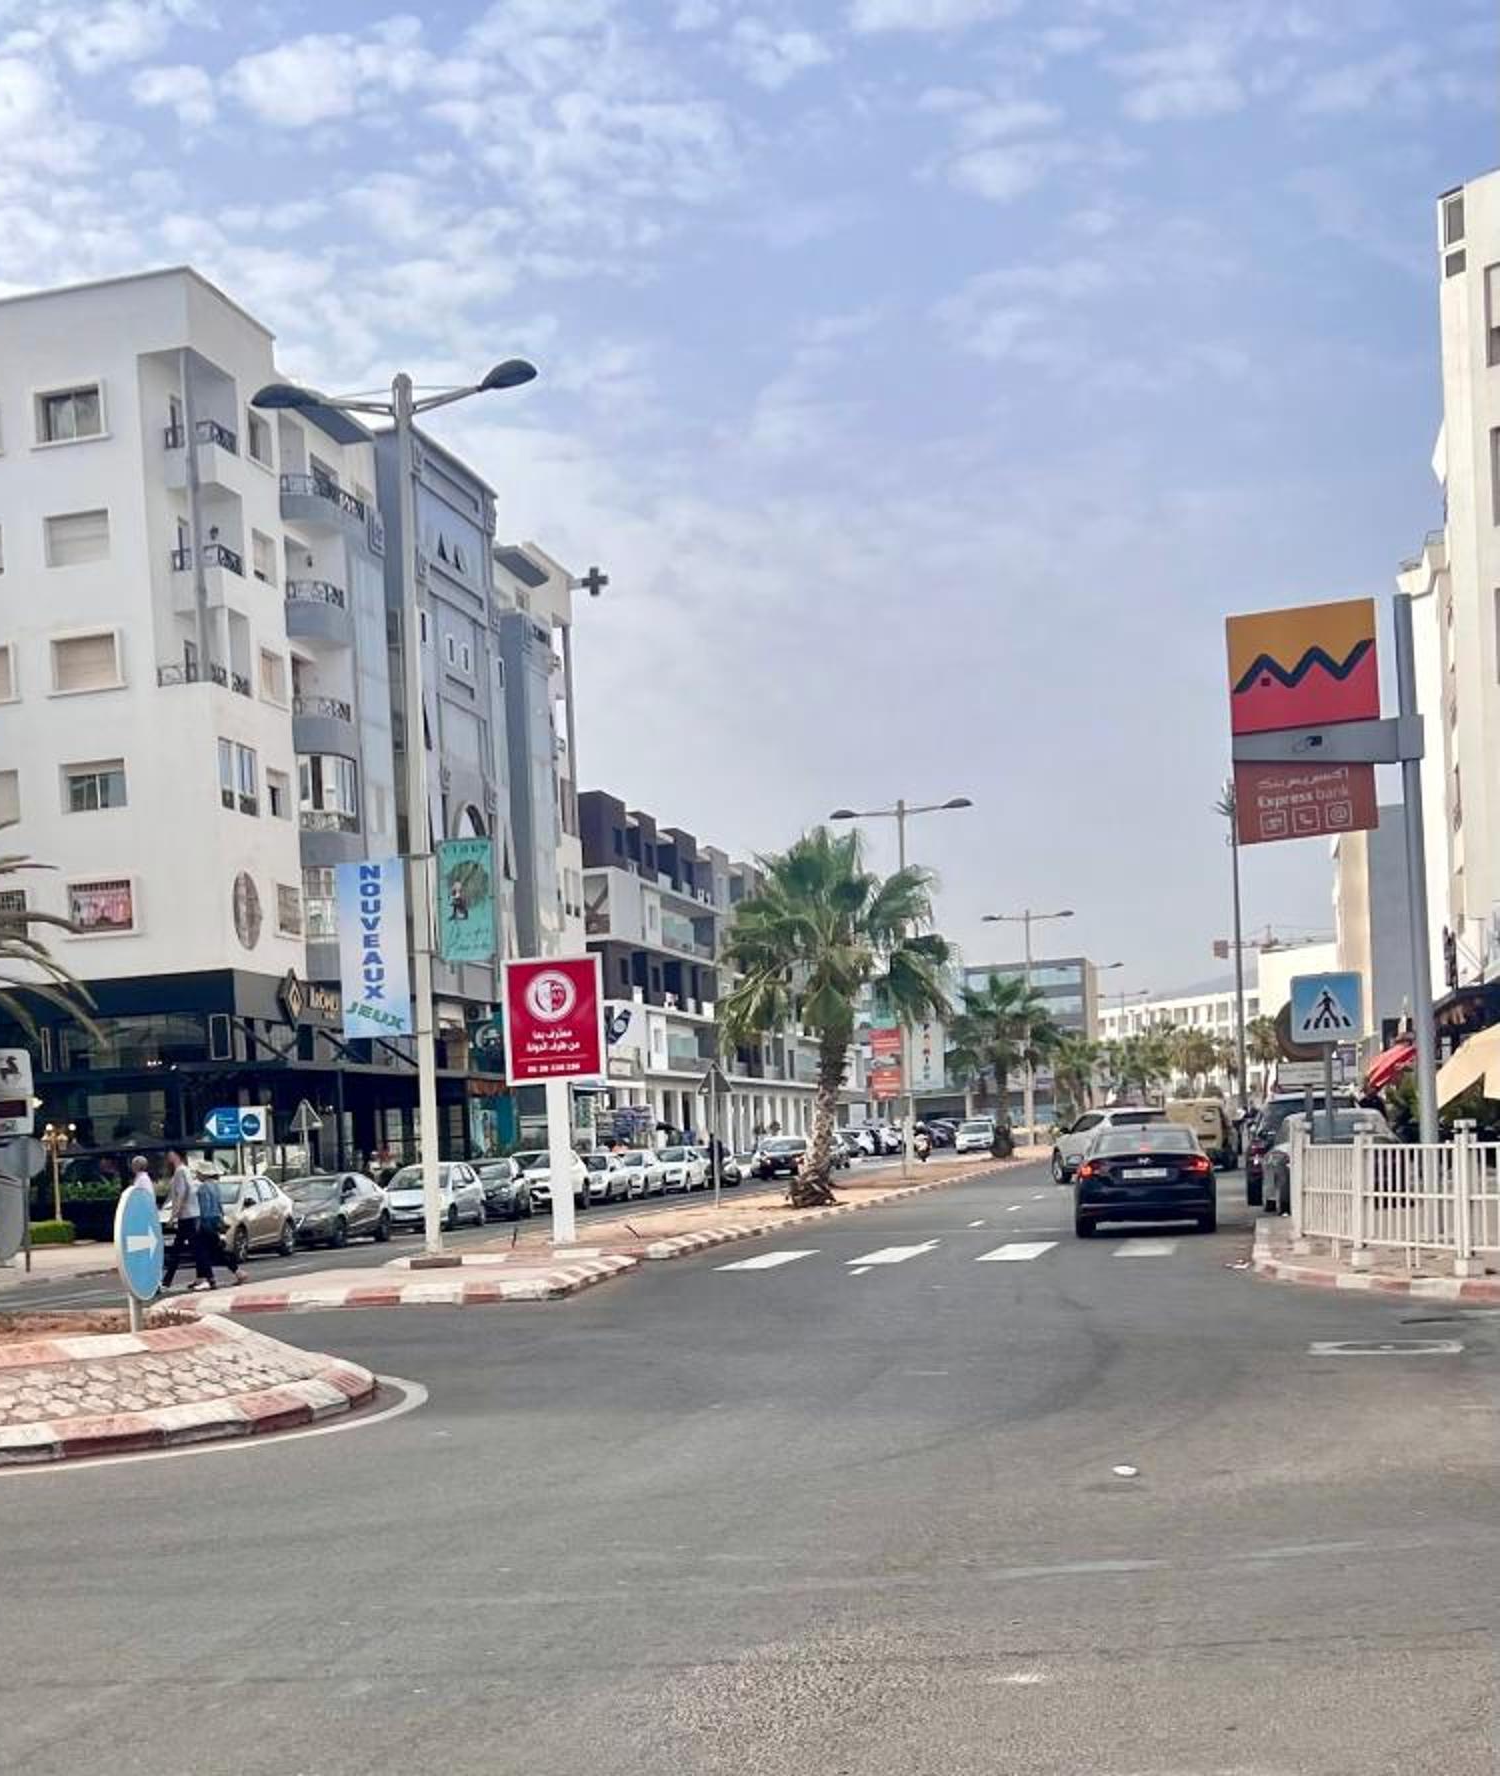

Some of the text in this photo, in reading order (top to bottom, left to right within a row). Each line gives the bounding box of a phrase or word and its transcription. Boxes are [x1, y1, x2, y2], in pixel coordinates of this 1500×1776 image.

[1257, 784, 1349, 808] Express bank
[358, 865, 385, 1000] NOUVEAUX
[345, 1001, 406, 1031] JEUX
